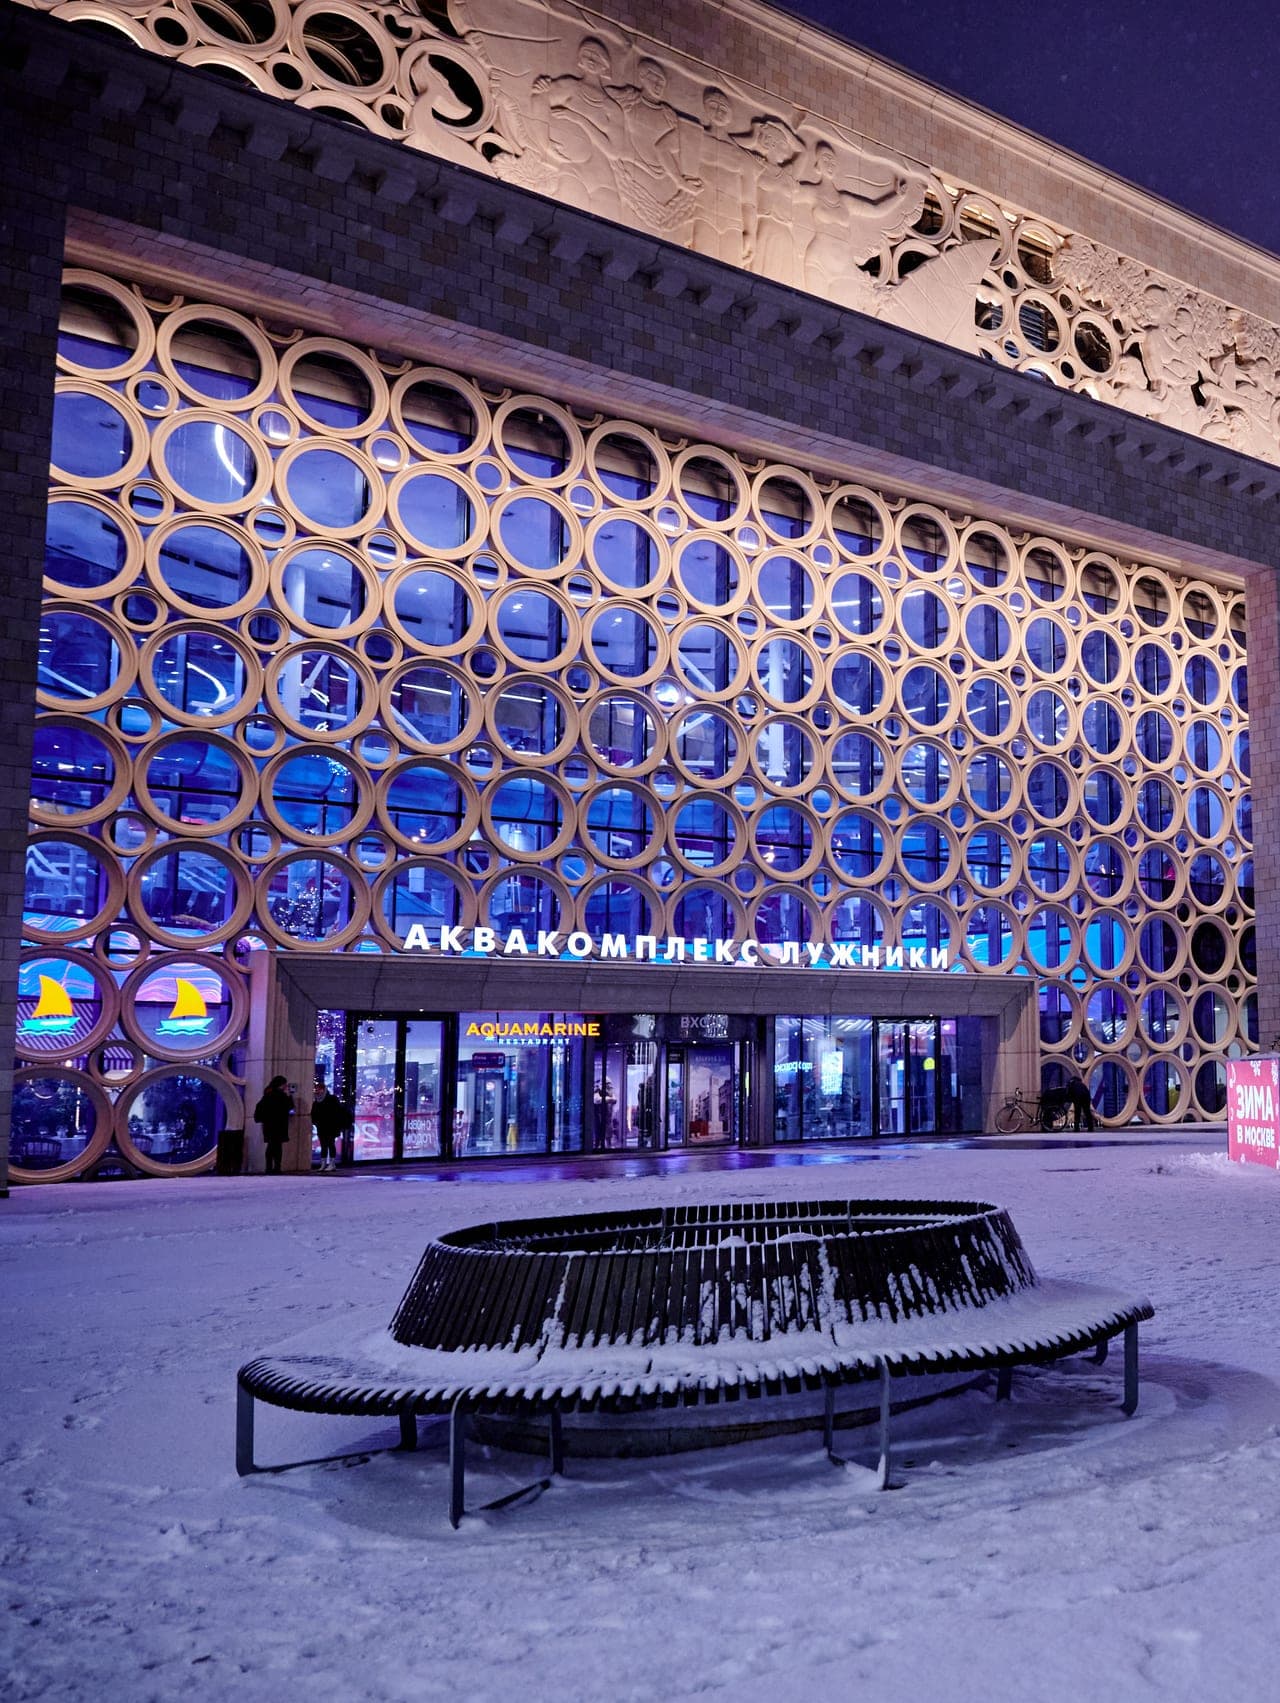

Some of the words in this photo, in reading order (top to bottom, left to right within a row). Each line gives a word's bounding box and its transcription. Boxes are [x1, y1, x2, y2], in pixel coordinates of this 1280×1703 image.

[403, 924, 758, 962] АКВАКОМПЛЕКС
[780, 941, 948, 969] ЛУЖНИКИ
[466, 1023, 600, 1036] AQUAMARINE
[680, 1016, 722, 1029] ВХО
[1236, 1085, 1275, 1122] ЗИМА
[1237, 1125, 1244, 1144] В
[1244, 1126, 1276, 1149] МОСКВЕ
